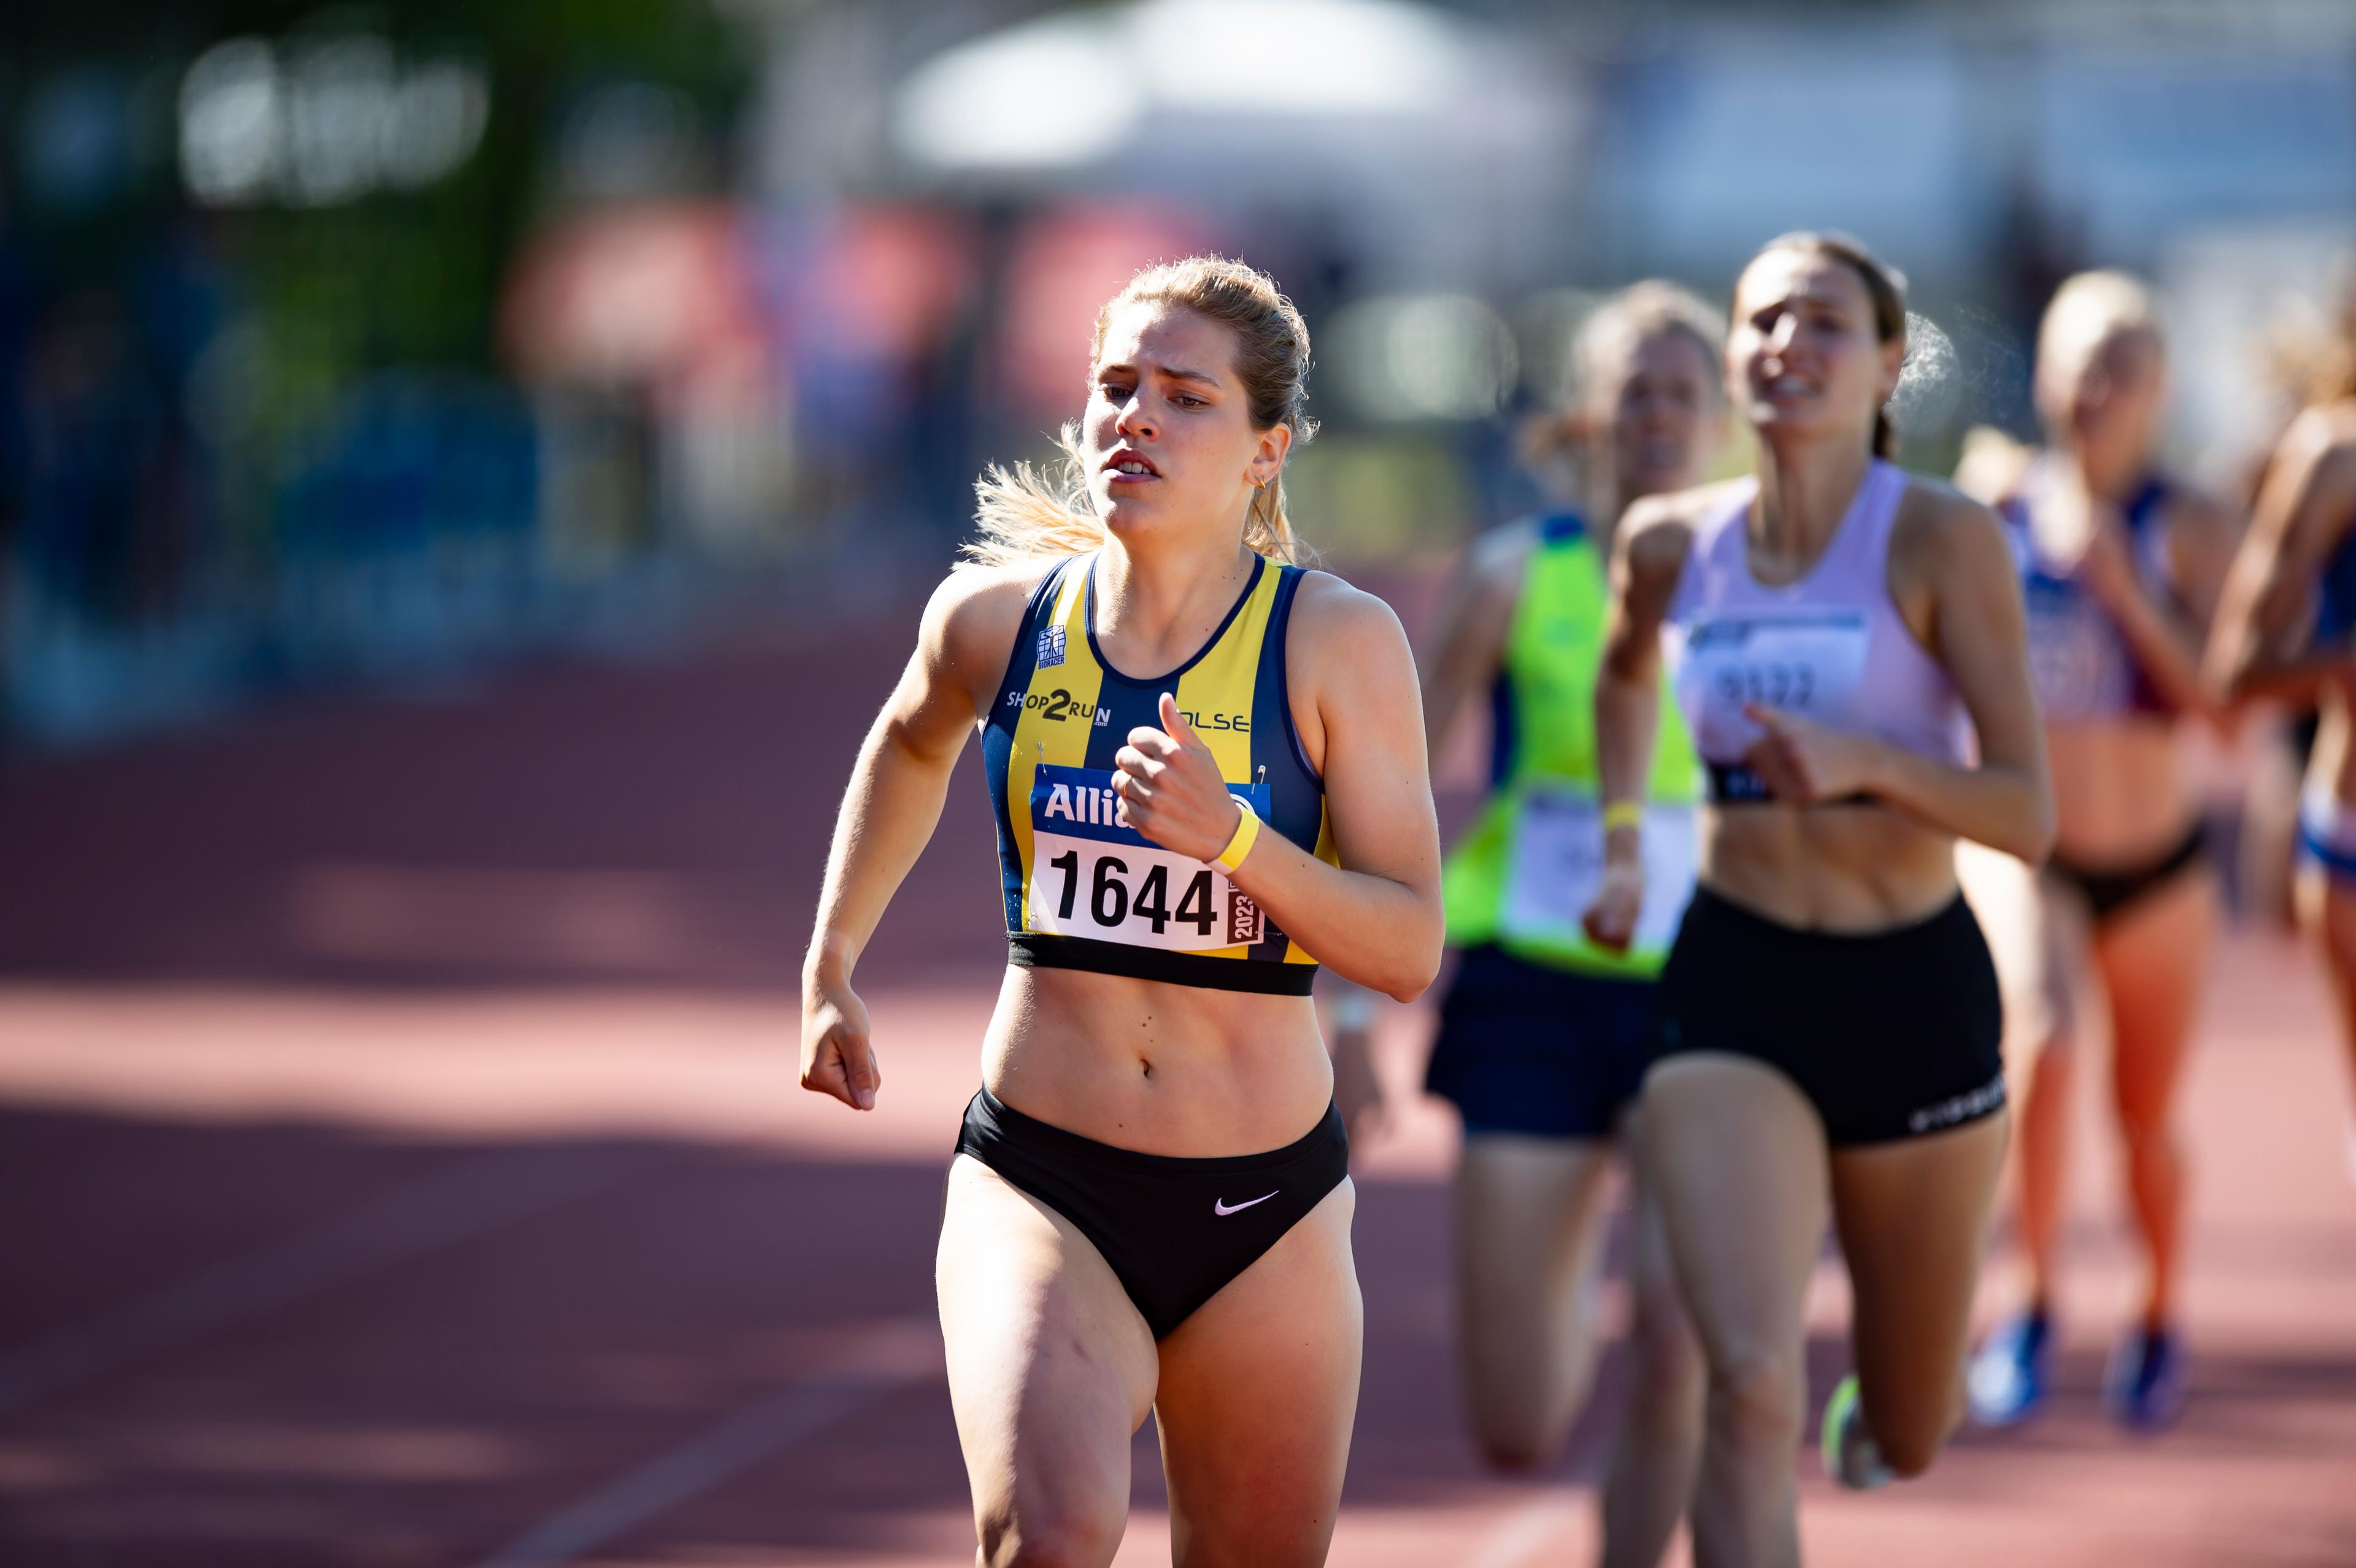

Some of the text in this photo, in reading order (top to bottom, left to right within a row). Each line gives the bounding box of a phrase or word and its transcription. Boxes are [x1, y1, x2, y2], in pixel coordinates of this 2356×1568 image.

[1038, 656, 1064, 669] BIORACER
[1007, 688, 1111, 723] SHOP2RUN
[1051, 850, 1217, 936] 1644
[1234, 895, 1254, 939] 2023
